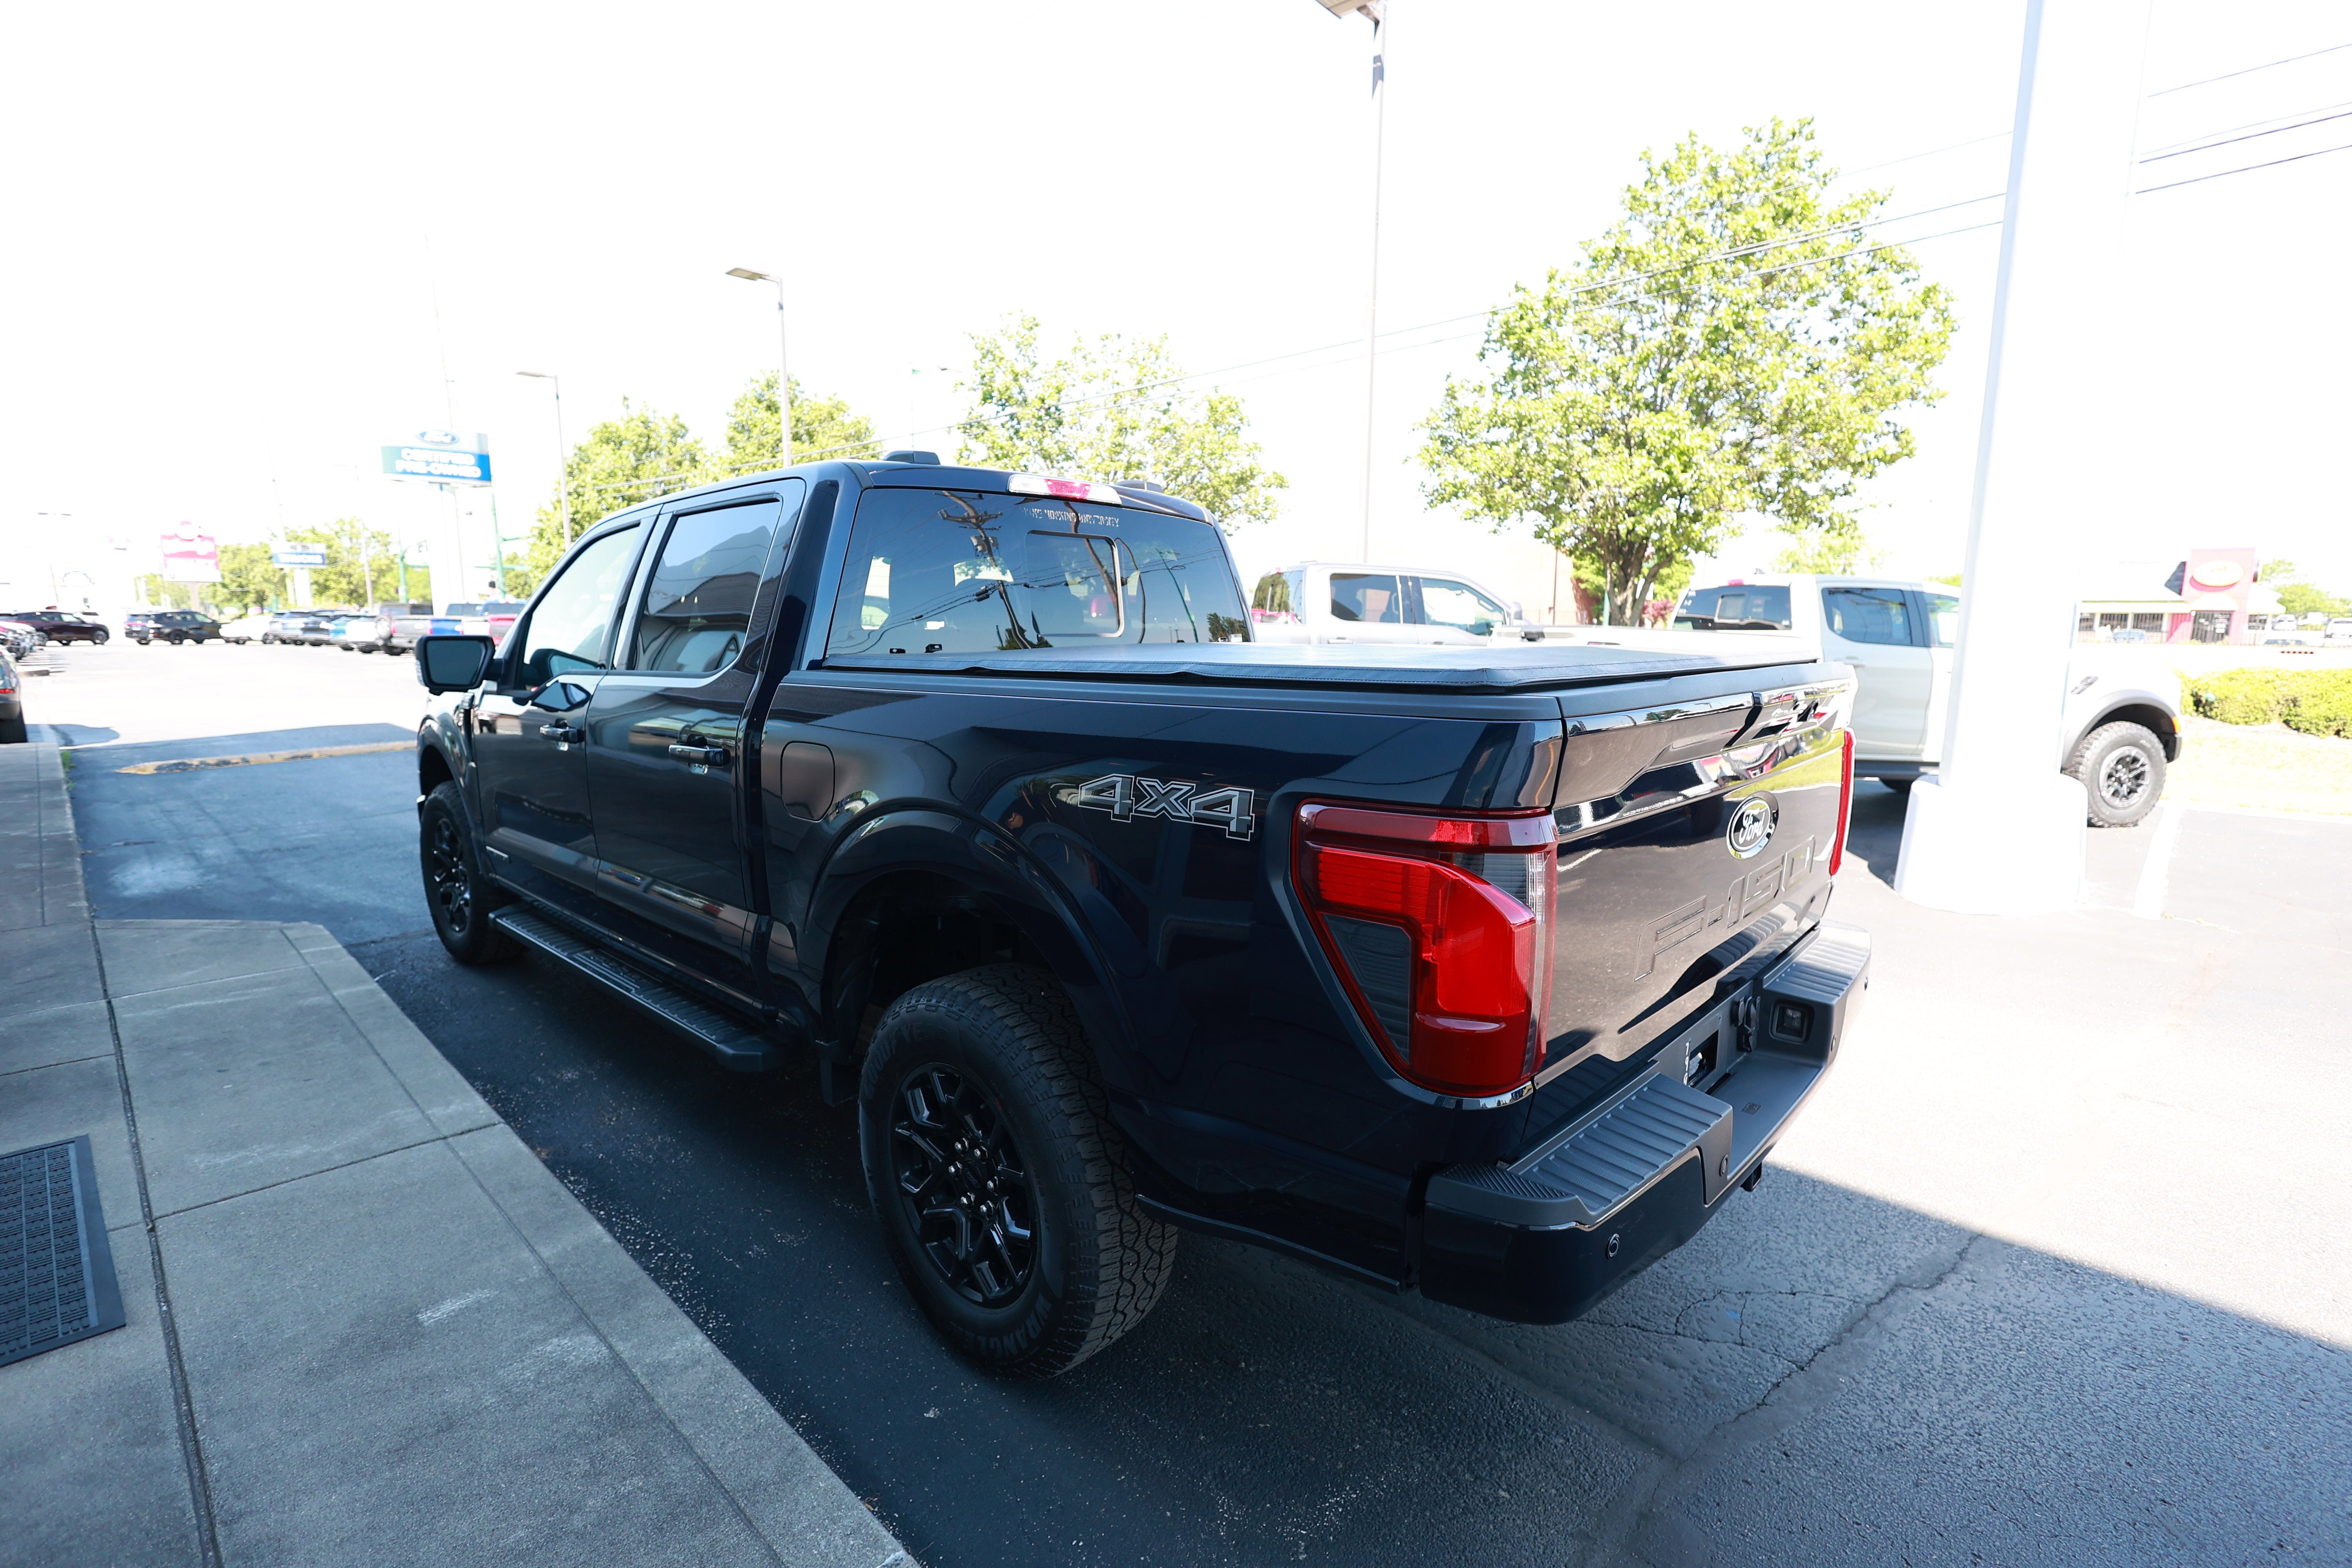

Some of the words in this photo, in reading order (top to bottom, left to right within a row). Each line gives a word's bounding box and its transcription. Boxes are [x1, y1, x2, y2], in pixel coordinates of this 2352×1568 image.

[401, 448, 475, 466] CERTIFIED
[395, 459, 481, 478] PRE-OWNED
[1739, 807, 1765, 844] Ford
[1634, 834, 1817, 982] F-150
[1350, 937, 1406, 953] FORD
